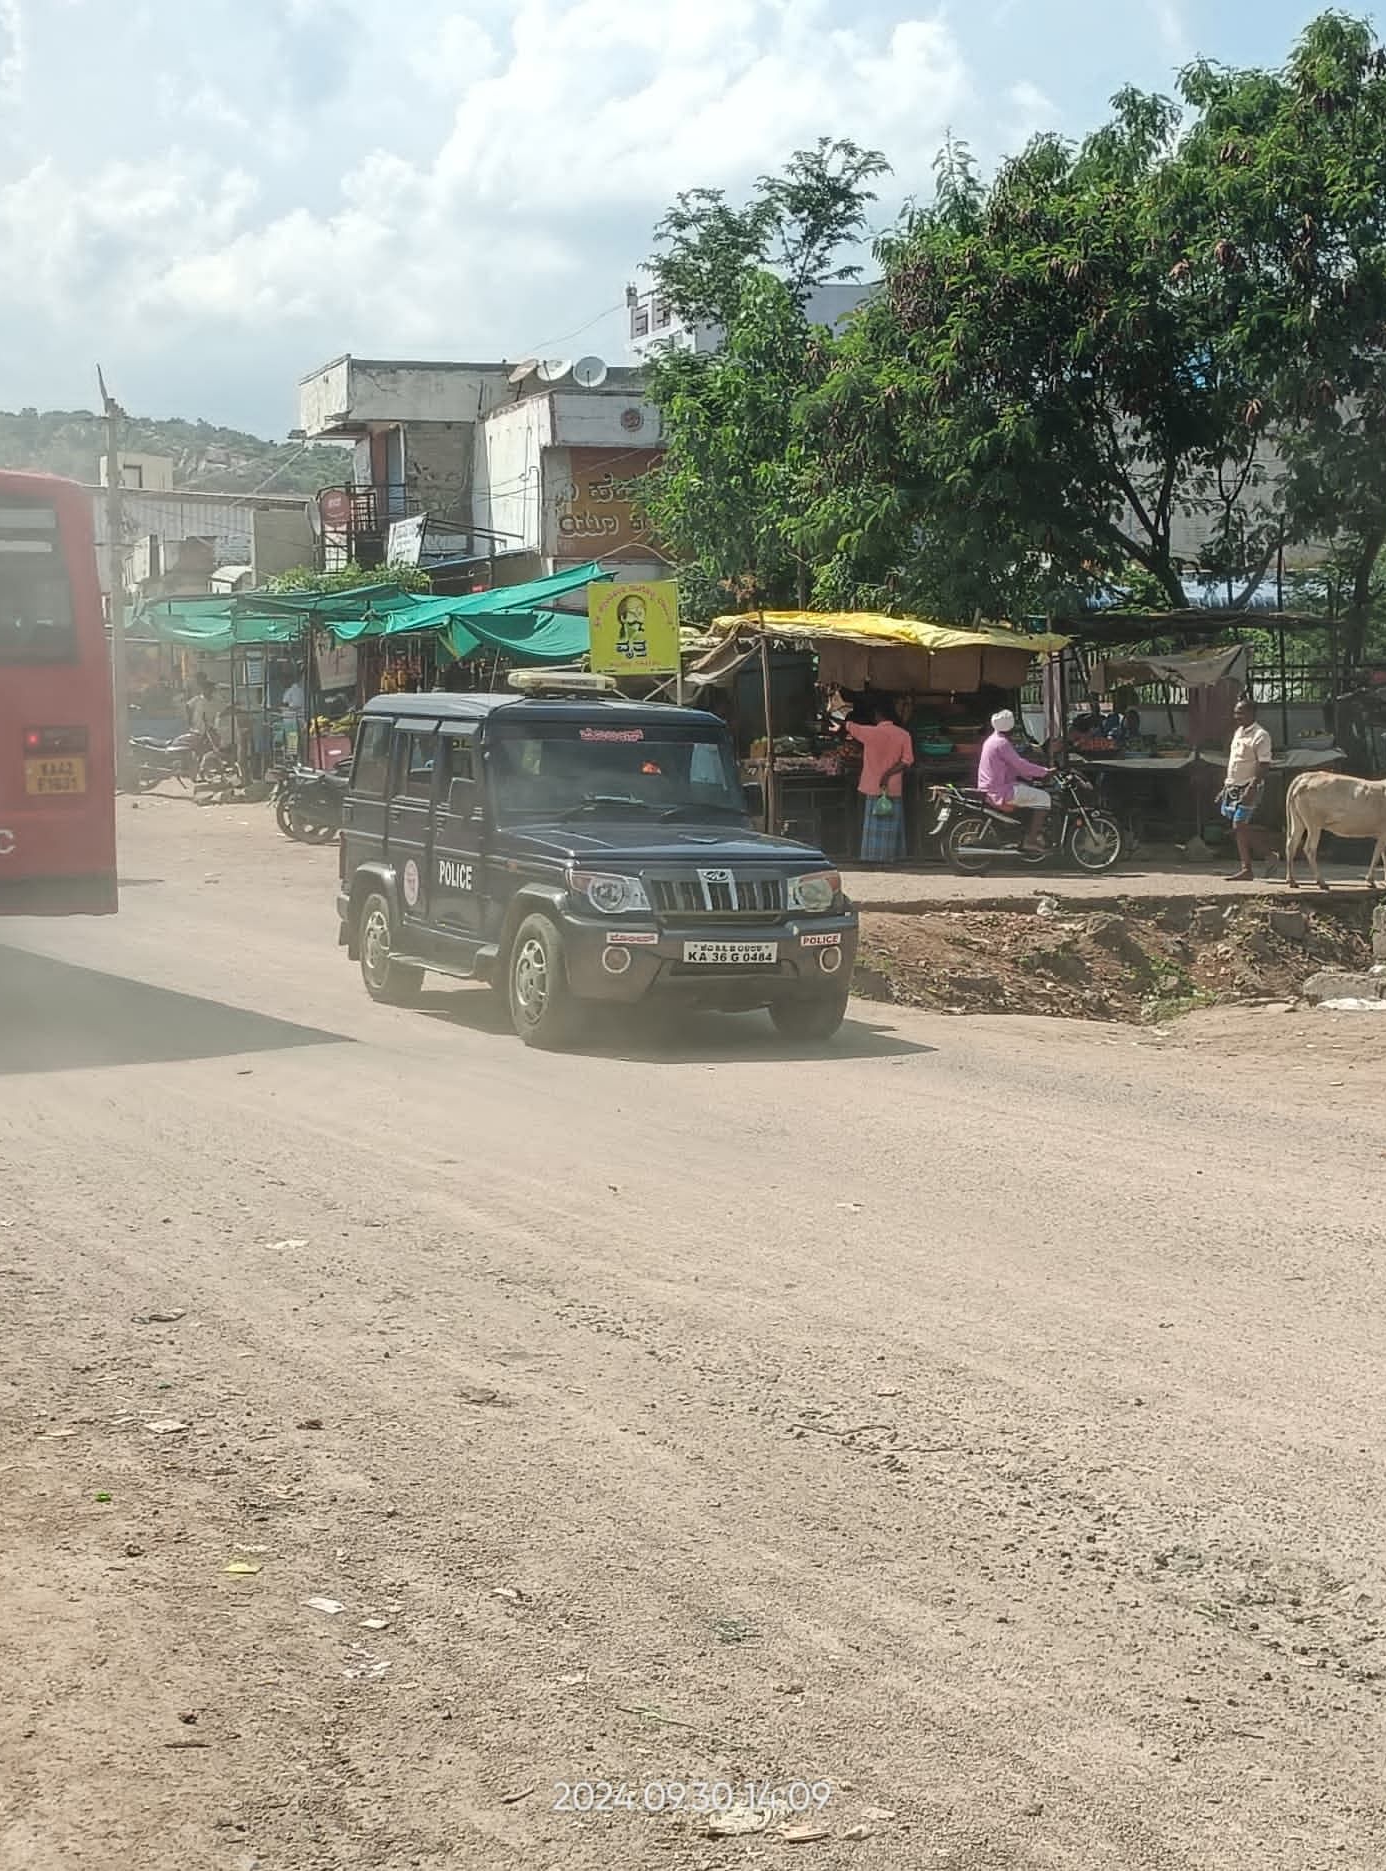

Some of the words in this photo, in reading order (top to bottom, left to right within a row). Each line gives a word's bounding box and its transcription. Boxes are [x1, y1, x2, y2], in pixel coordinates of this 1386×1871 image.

[438, 860, 473, 891] POLICE
[803, 935, 839, 944] POLICE
[688, 952, 708, 962] KA
[712, 952, 728, 962] 36
[731, 952, 740, 962] G
